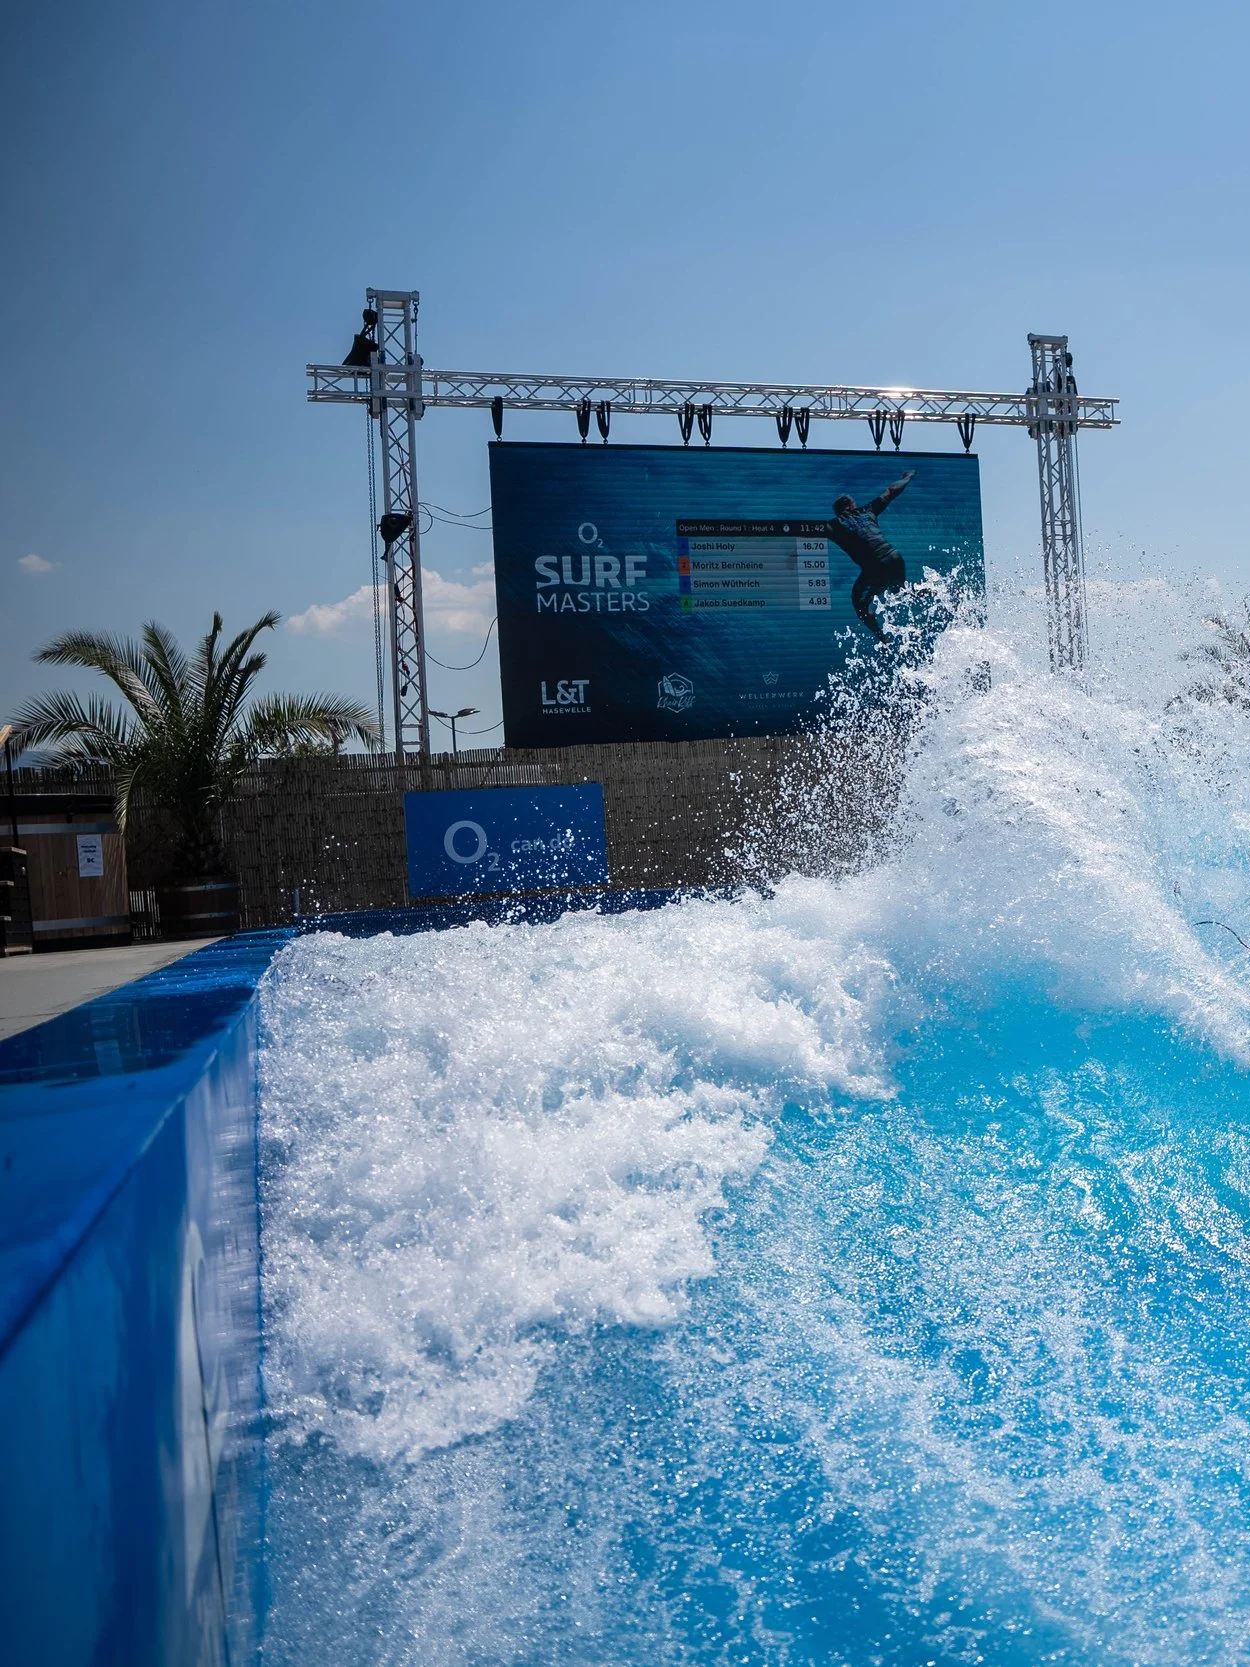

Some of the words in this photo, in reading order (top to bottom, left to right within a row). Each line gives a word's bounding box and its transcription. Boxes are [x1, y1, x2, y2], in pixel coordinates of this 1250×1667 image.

[679, 524, 698, 533] Open
[720, 524, 742, 532] Round
[800, 524, 825, 532] 11:42
[691, 542, 714, 550] Joshi
[715, 542, 736, 552] Holy
[802, 542, 825, 551] 16.70
[692, 561, 720, 570] Moritz
[803, 560, 826, 569] 15.00
[534, 554, 648, 589] SURF
[693, 580, 720, 588] Simon
[721, 579, 760, 588] Wüthrich
[808, 579, 827, 588] 5.83
[536, 591, 650, 613] MASTERS
[694, 599, 721, 608] Jakob
[721, 599, 766, 611] Suedkamp
[809, 597, 828, 606] 4.93
[541, 679, 590, 705] L&T
[542, 706, 592, 715] HASEWELLE
[510, 837, 546, 852] can
